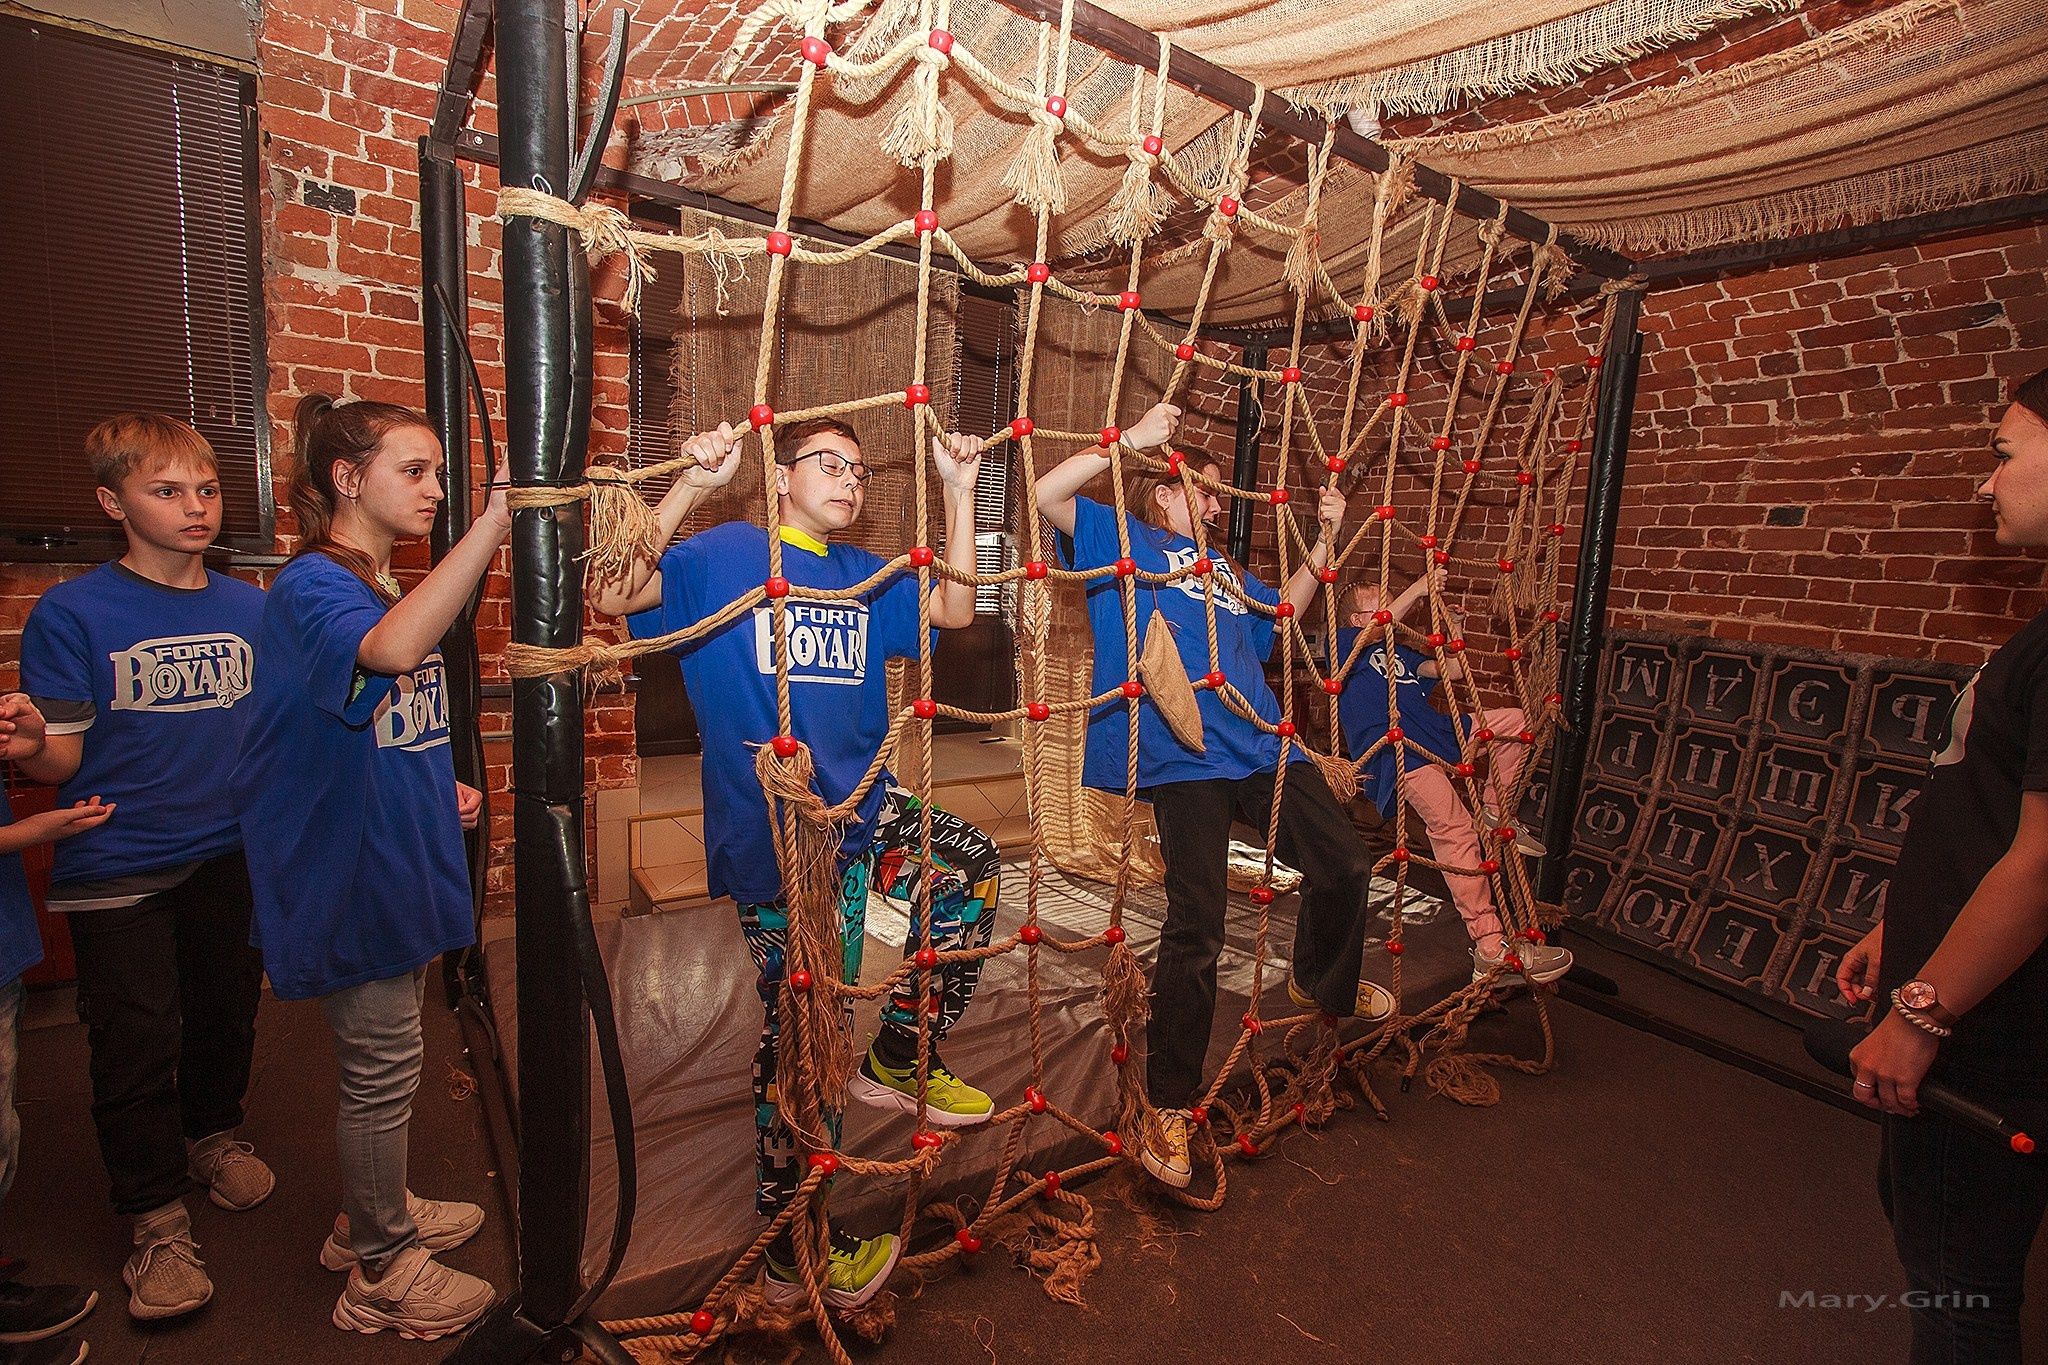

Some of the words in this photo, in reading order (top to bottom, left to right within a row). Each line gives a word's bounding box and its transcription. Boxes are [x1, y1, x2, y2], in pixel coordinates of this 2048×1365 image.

[795, 606, 858, 626] FORT
[155, 642, 226, 662] FORT
[109, 641, 254, 712] BOYARD
[1617, 656, 1665, 699] М
[1705, 664, 1743, 712] Д
[373, 674, 451, 748] BOYA
[1788, 680, 1830, 726] Э
[1611, 730, 1643, 769] Р
[1681, 743, 1729, 789] П
[1585, 800, 1626, 838] Ф
[1866, 782, 1921, 833] Я
[930, 829, 987, 859] JAM!
[1740, 842, 1792, 891] Х
[1622, 889, 1687, 939] Ю
[1714, 919, 1758, 969] Е
